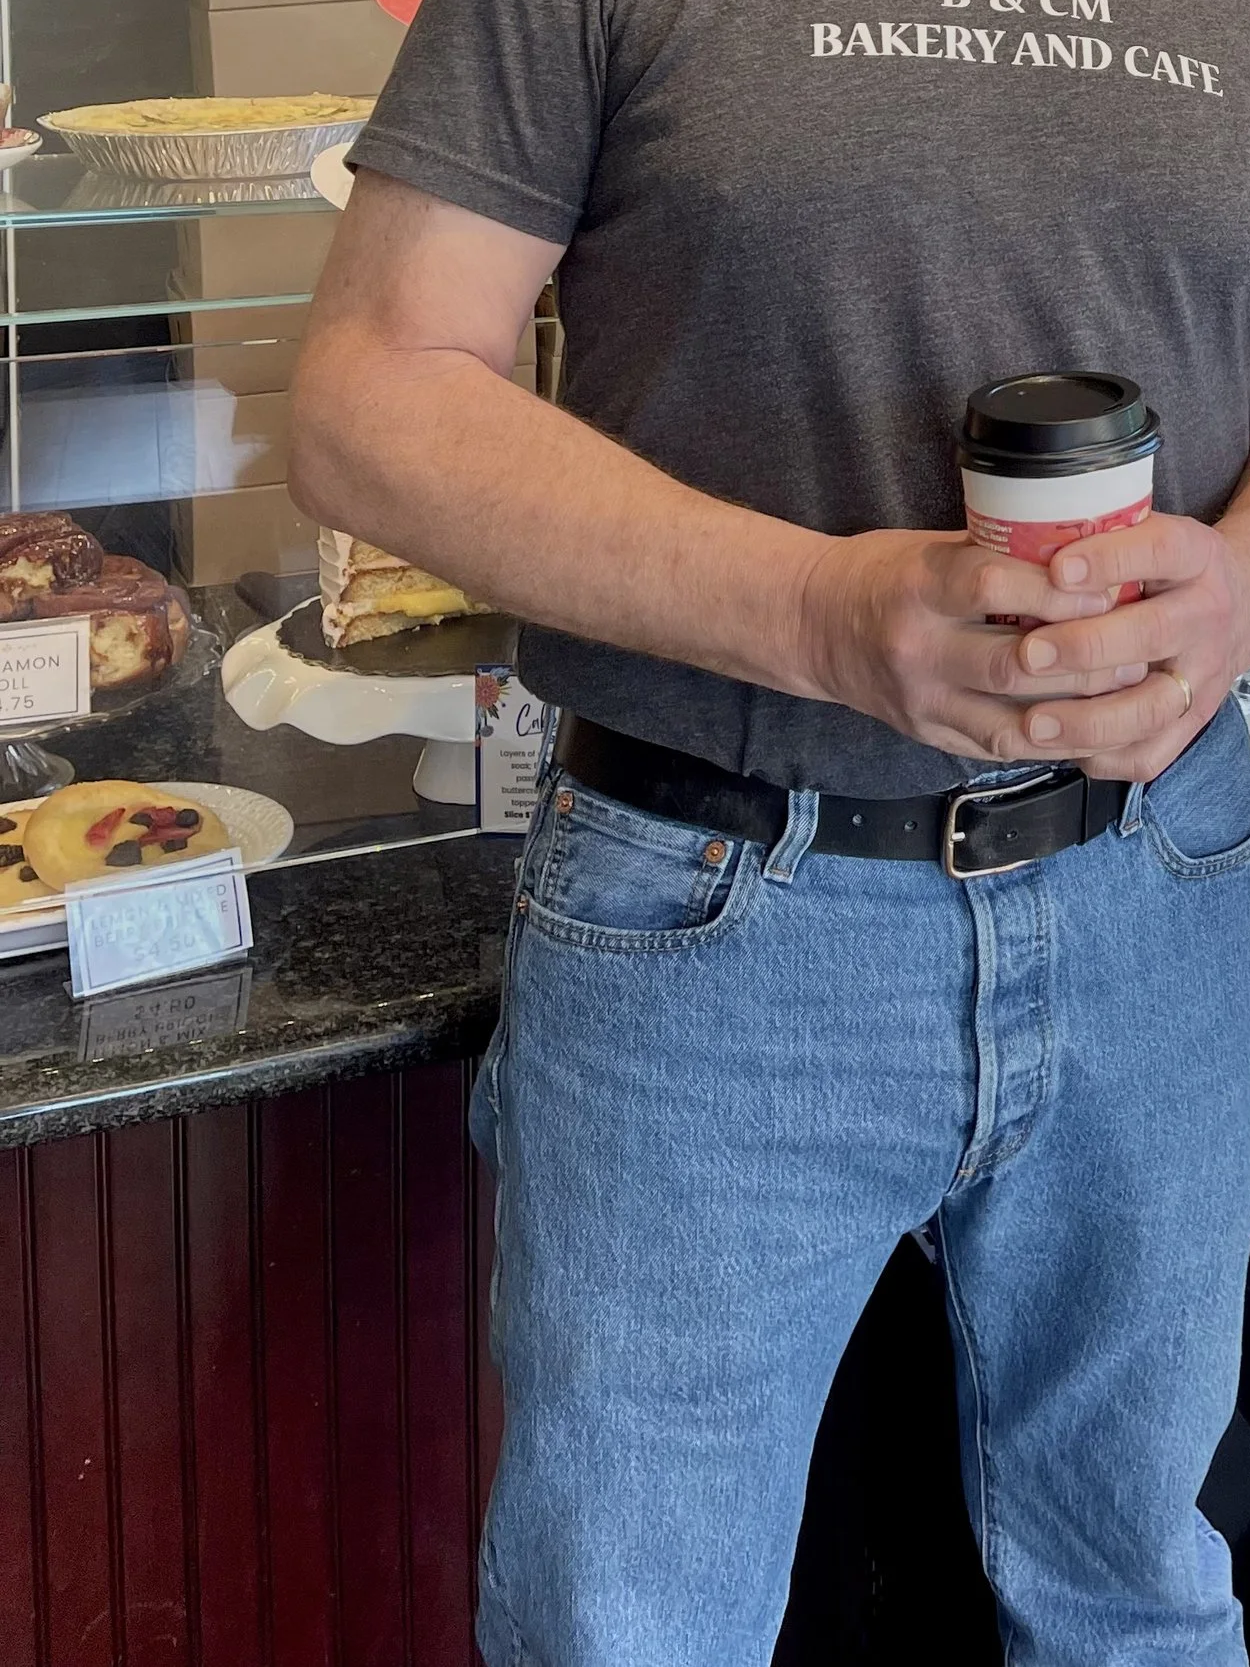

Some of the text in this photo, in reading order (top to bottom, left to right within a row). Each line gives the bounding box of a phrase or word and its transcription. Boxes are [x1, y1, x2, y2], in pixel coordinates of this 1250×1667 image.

[810, 22, 1224, 97] BAKERY AND CAFE
[500, 749, 536, 760] Layers of
